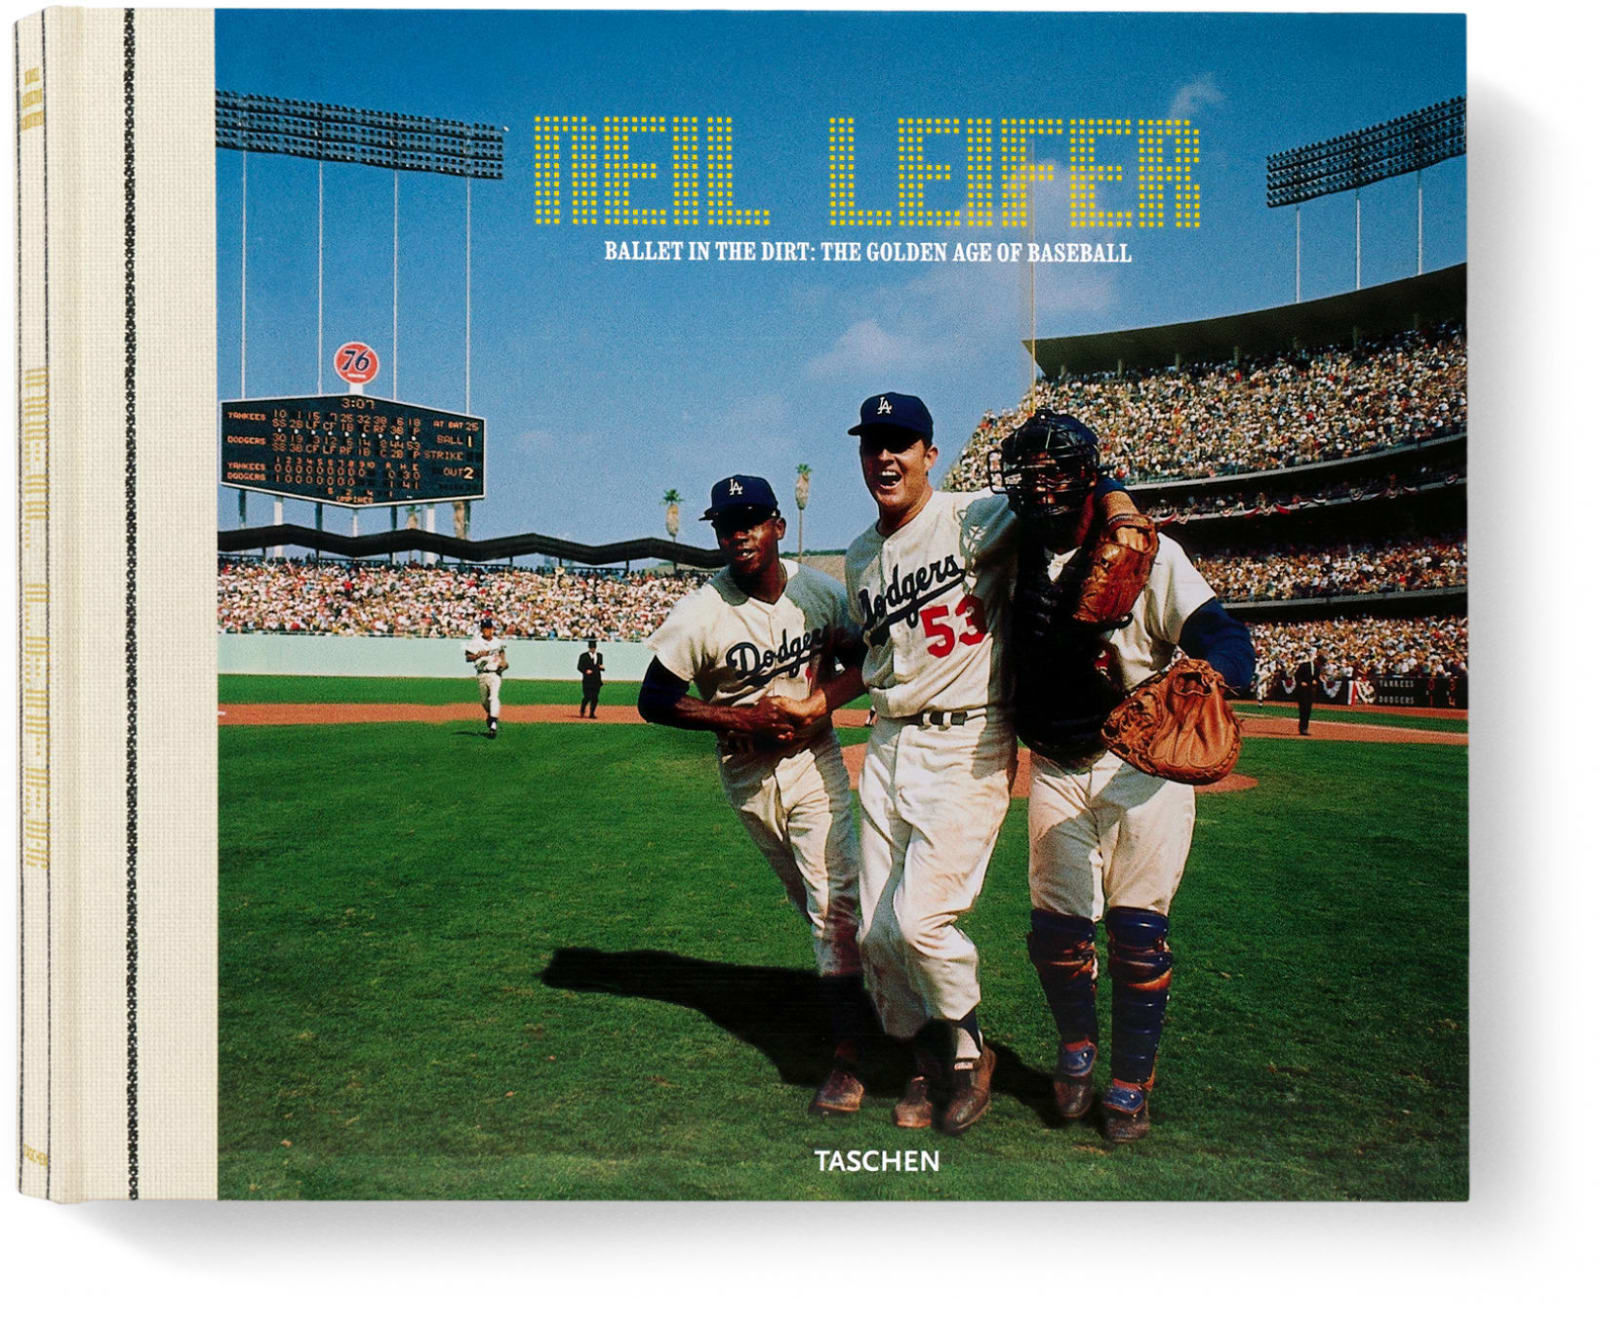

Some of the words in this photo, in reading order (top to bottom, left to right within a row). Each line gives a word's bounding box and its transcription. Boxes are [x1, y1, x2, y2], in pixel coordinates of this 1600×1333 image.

[534, 116, 770, 226] NEIL
[829, 117, 1200, 228] LEIFER
[605, 241, 684, 261] BALLET
[688, 241, 711, 261] IN
[715, 241, 756, 261] THE
[761, 241, 815, 261] DIRT:
[820, 242, 861, 261] THE
[866, 242, 948, 262] GOLDEN
[953, 242, 992, 262] AGE
[996, 242, 1023, 263] OF
[1027, 242, 1132, 263] BASEBALL
[342, 350, 369, 372] 76
[342, 398, 375, 409] 3:07
[919, 594, 987, 658] 53
[814, 1150, 940, 1172] TASCHEN
